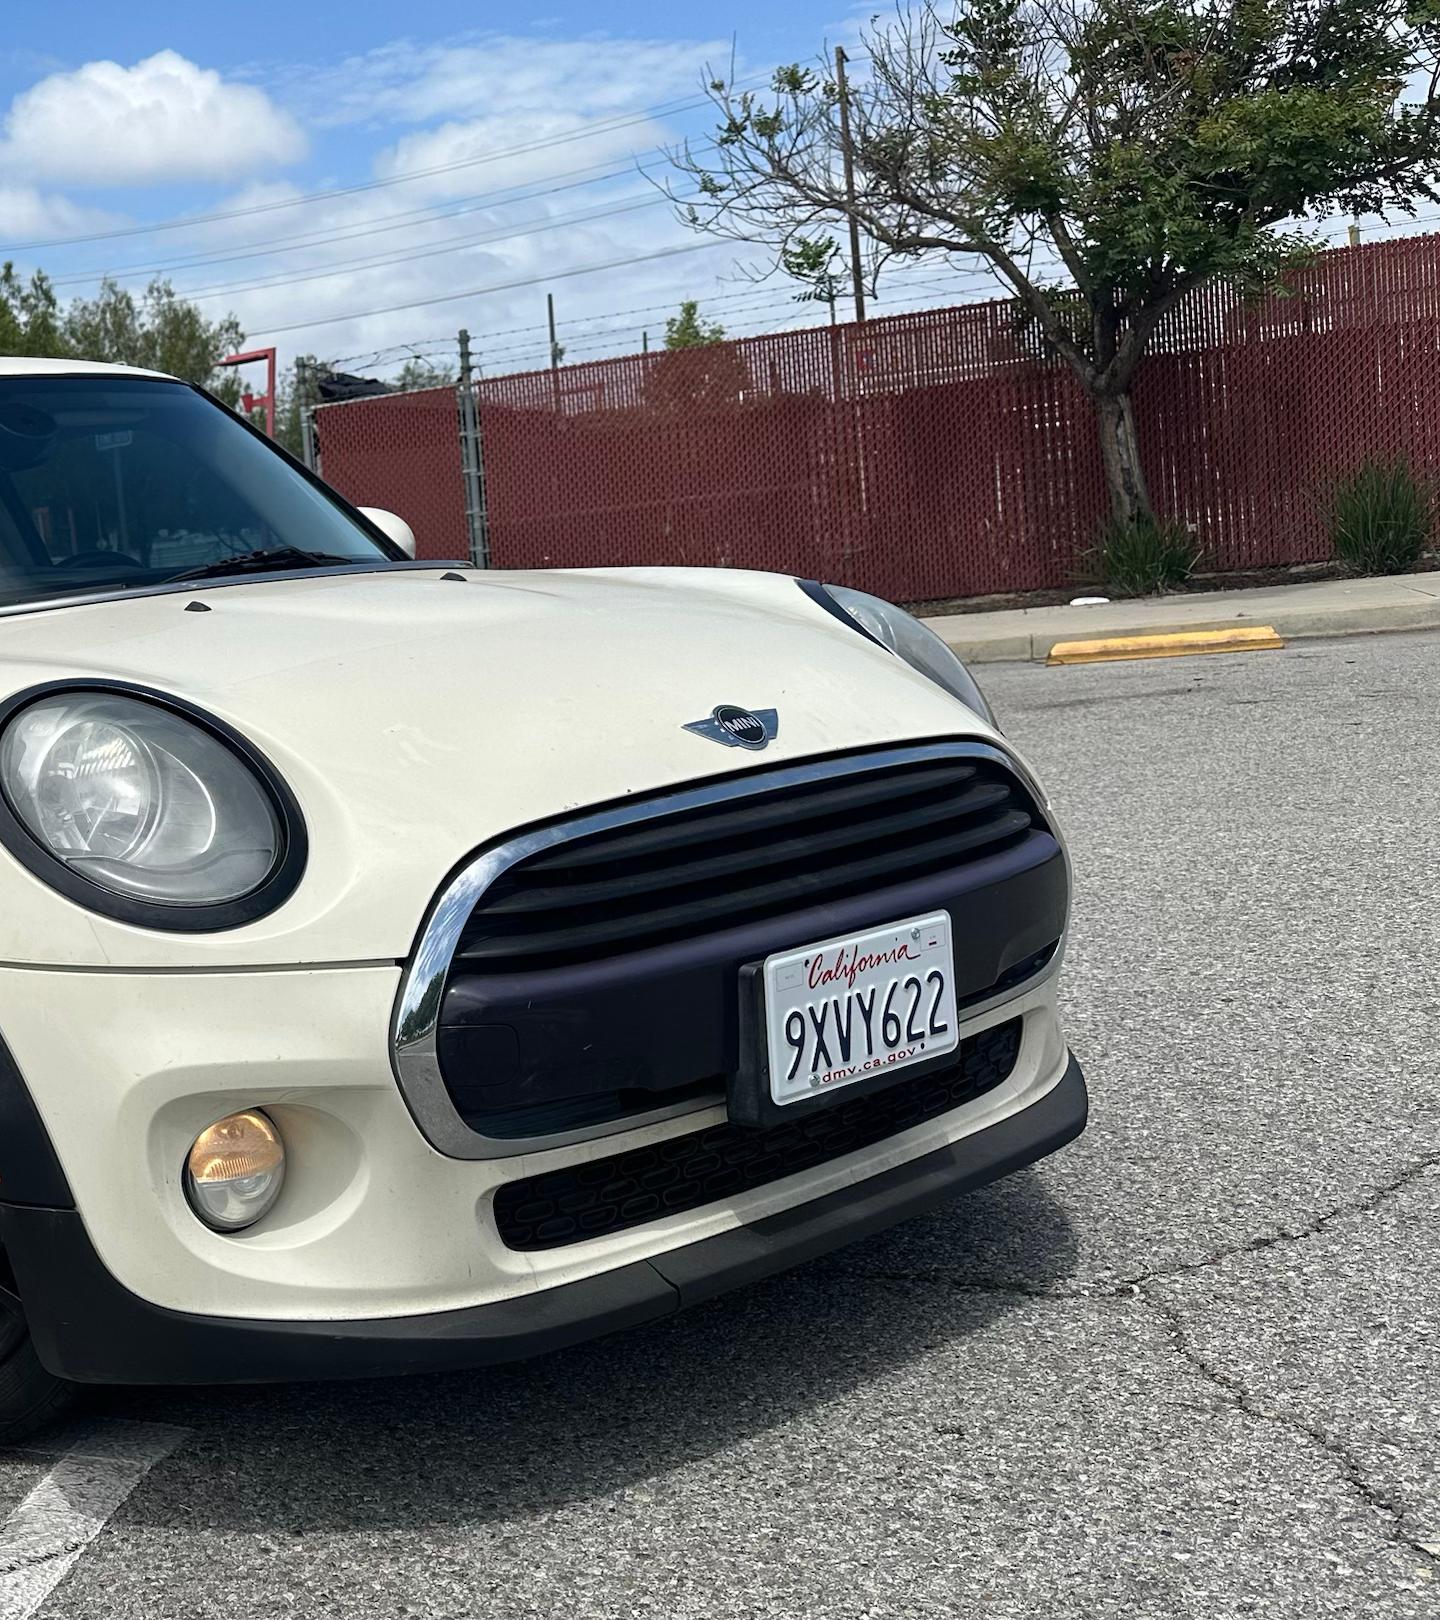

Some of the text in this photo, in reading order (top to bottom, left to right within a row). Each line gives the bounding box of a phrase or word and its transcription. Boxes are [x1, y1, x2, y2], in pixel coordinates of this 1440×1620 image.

[724, 716, 761, 732] MINI
[808, 937, 921, 989] California
[785, 970, 948, 1080] 9XVY622
[822, 1047, 916, 1083] dmv.ca.gov
